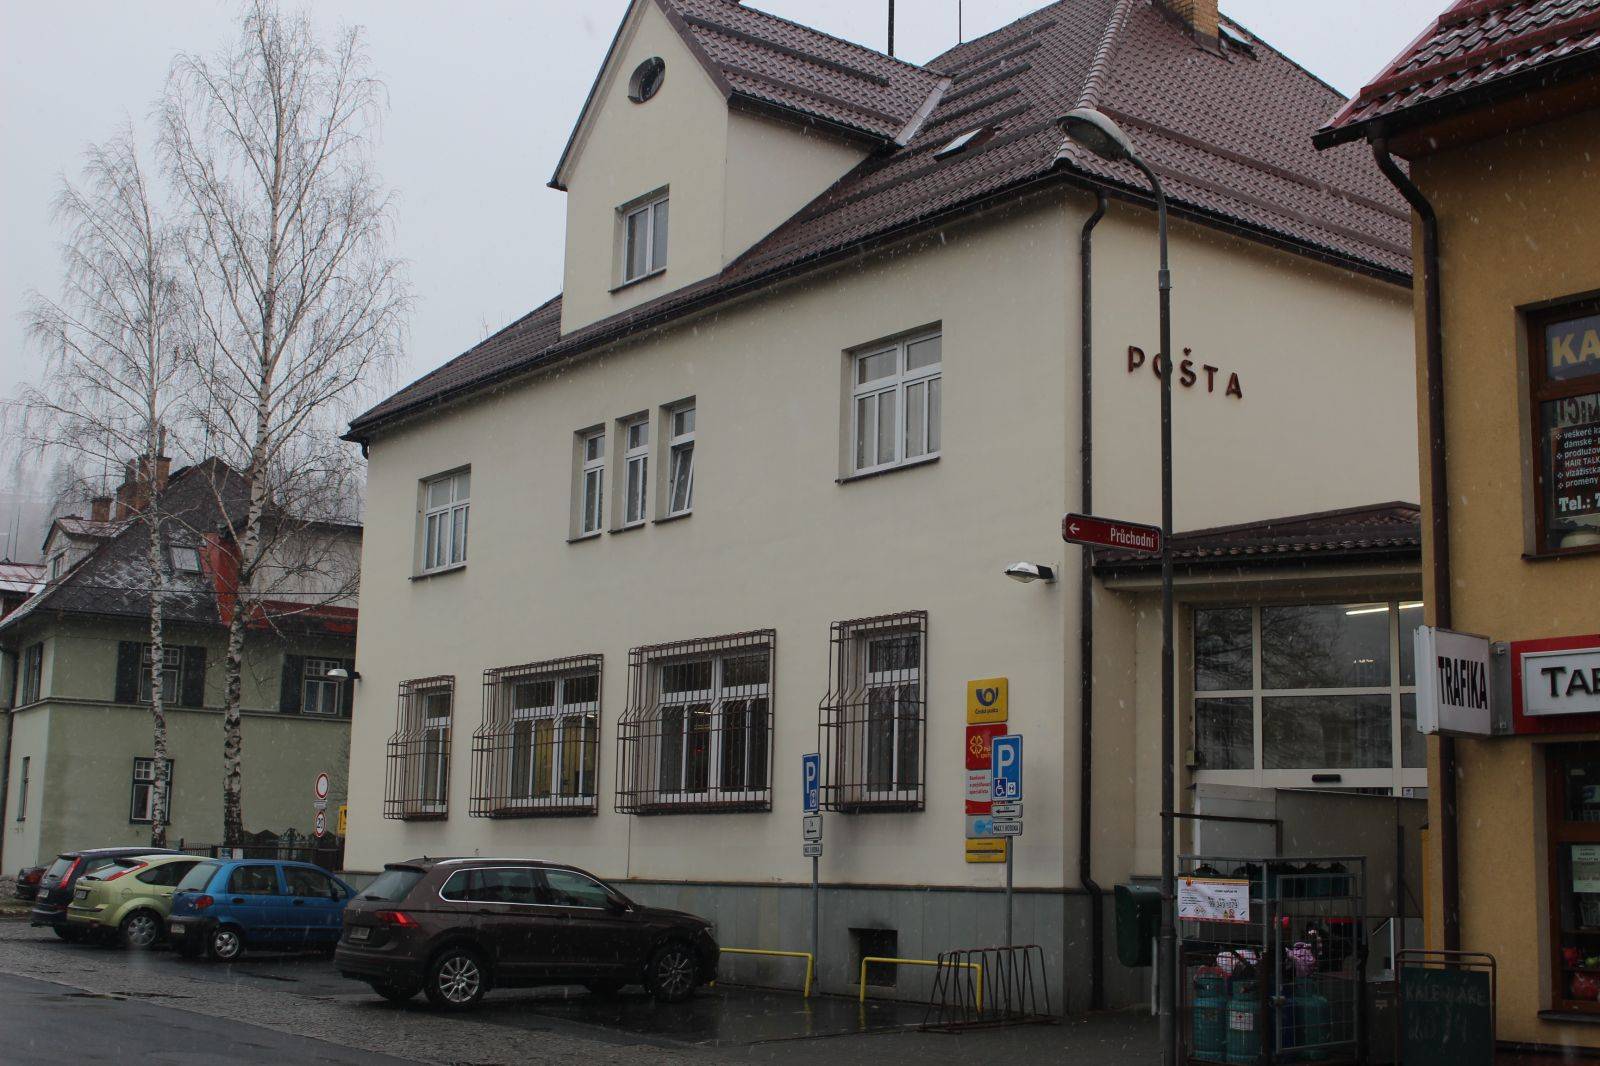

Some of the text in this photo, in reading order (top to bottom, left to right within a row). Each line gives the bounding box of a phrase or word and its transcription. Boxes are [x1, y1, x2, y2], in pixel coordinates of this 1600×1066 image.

[1128, 345, 1242, 399] POŠTA
[1565, 459, 1582, 467] HAIR
[1559, 495, 1591, 512] Tel.:
[1110, 527, 1154, 548] Průchodní
[1438, 656, 1488, 710] TRAFIKA
[998, 744, 1015, 778] P
[806, 761, 816, 794] P
[316, 817, 324, 829] 20
